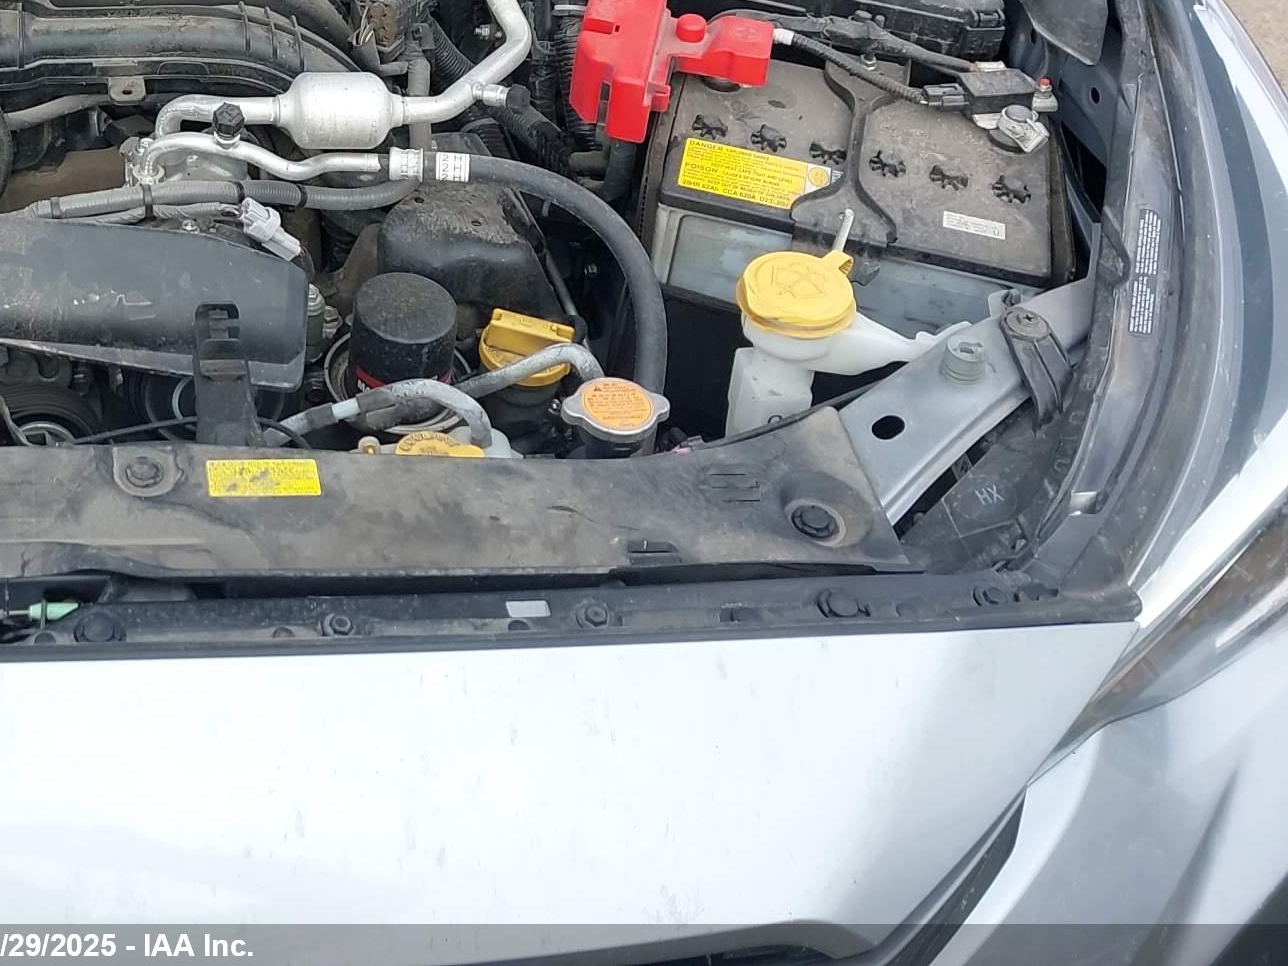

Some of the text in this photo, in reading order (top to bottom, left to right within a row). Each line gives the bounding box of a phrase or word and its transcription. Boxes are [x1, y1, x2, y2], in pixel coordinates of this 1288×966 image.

[688, 139, 723, 152] DANGER
[684, 161, 719, 174] POISON
[721, 187, 738, 196] CCA
[974, 484, 1005, 506] HX
